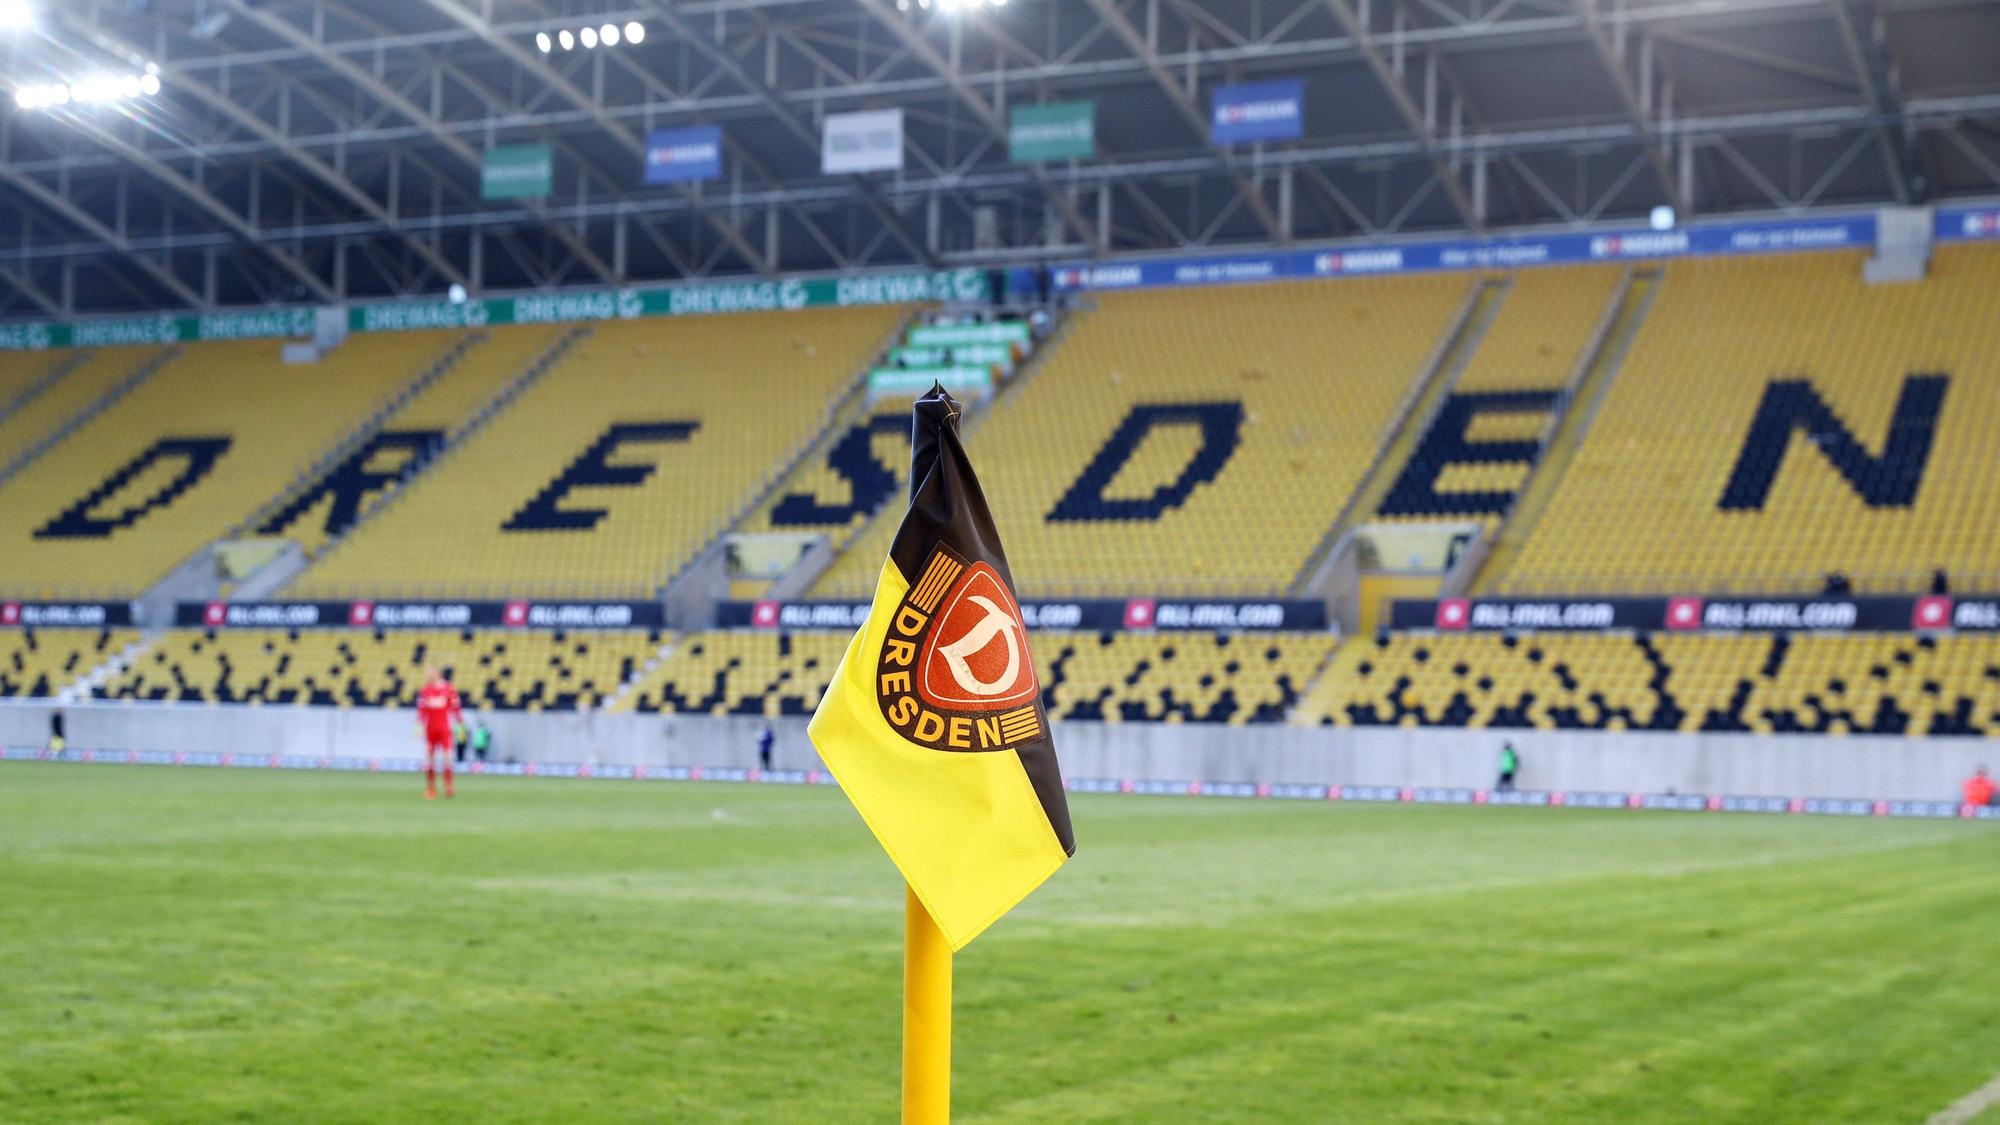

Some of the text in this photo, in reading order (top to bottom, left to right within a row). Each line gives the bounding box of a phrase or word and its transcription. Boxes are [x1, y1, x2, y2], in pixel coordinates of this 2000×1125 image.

[514, 293, 614, 324] DREWAG
[669, 282, 776, 314] DREWAG
[881, 605, 1001, 748] DRESDEN
